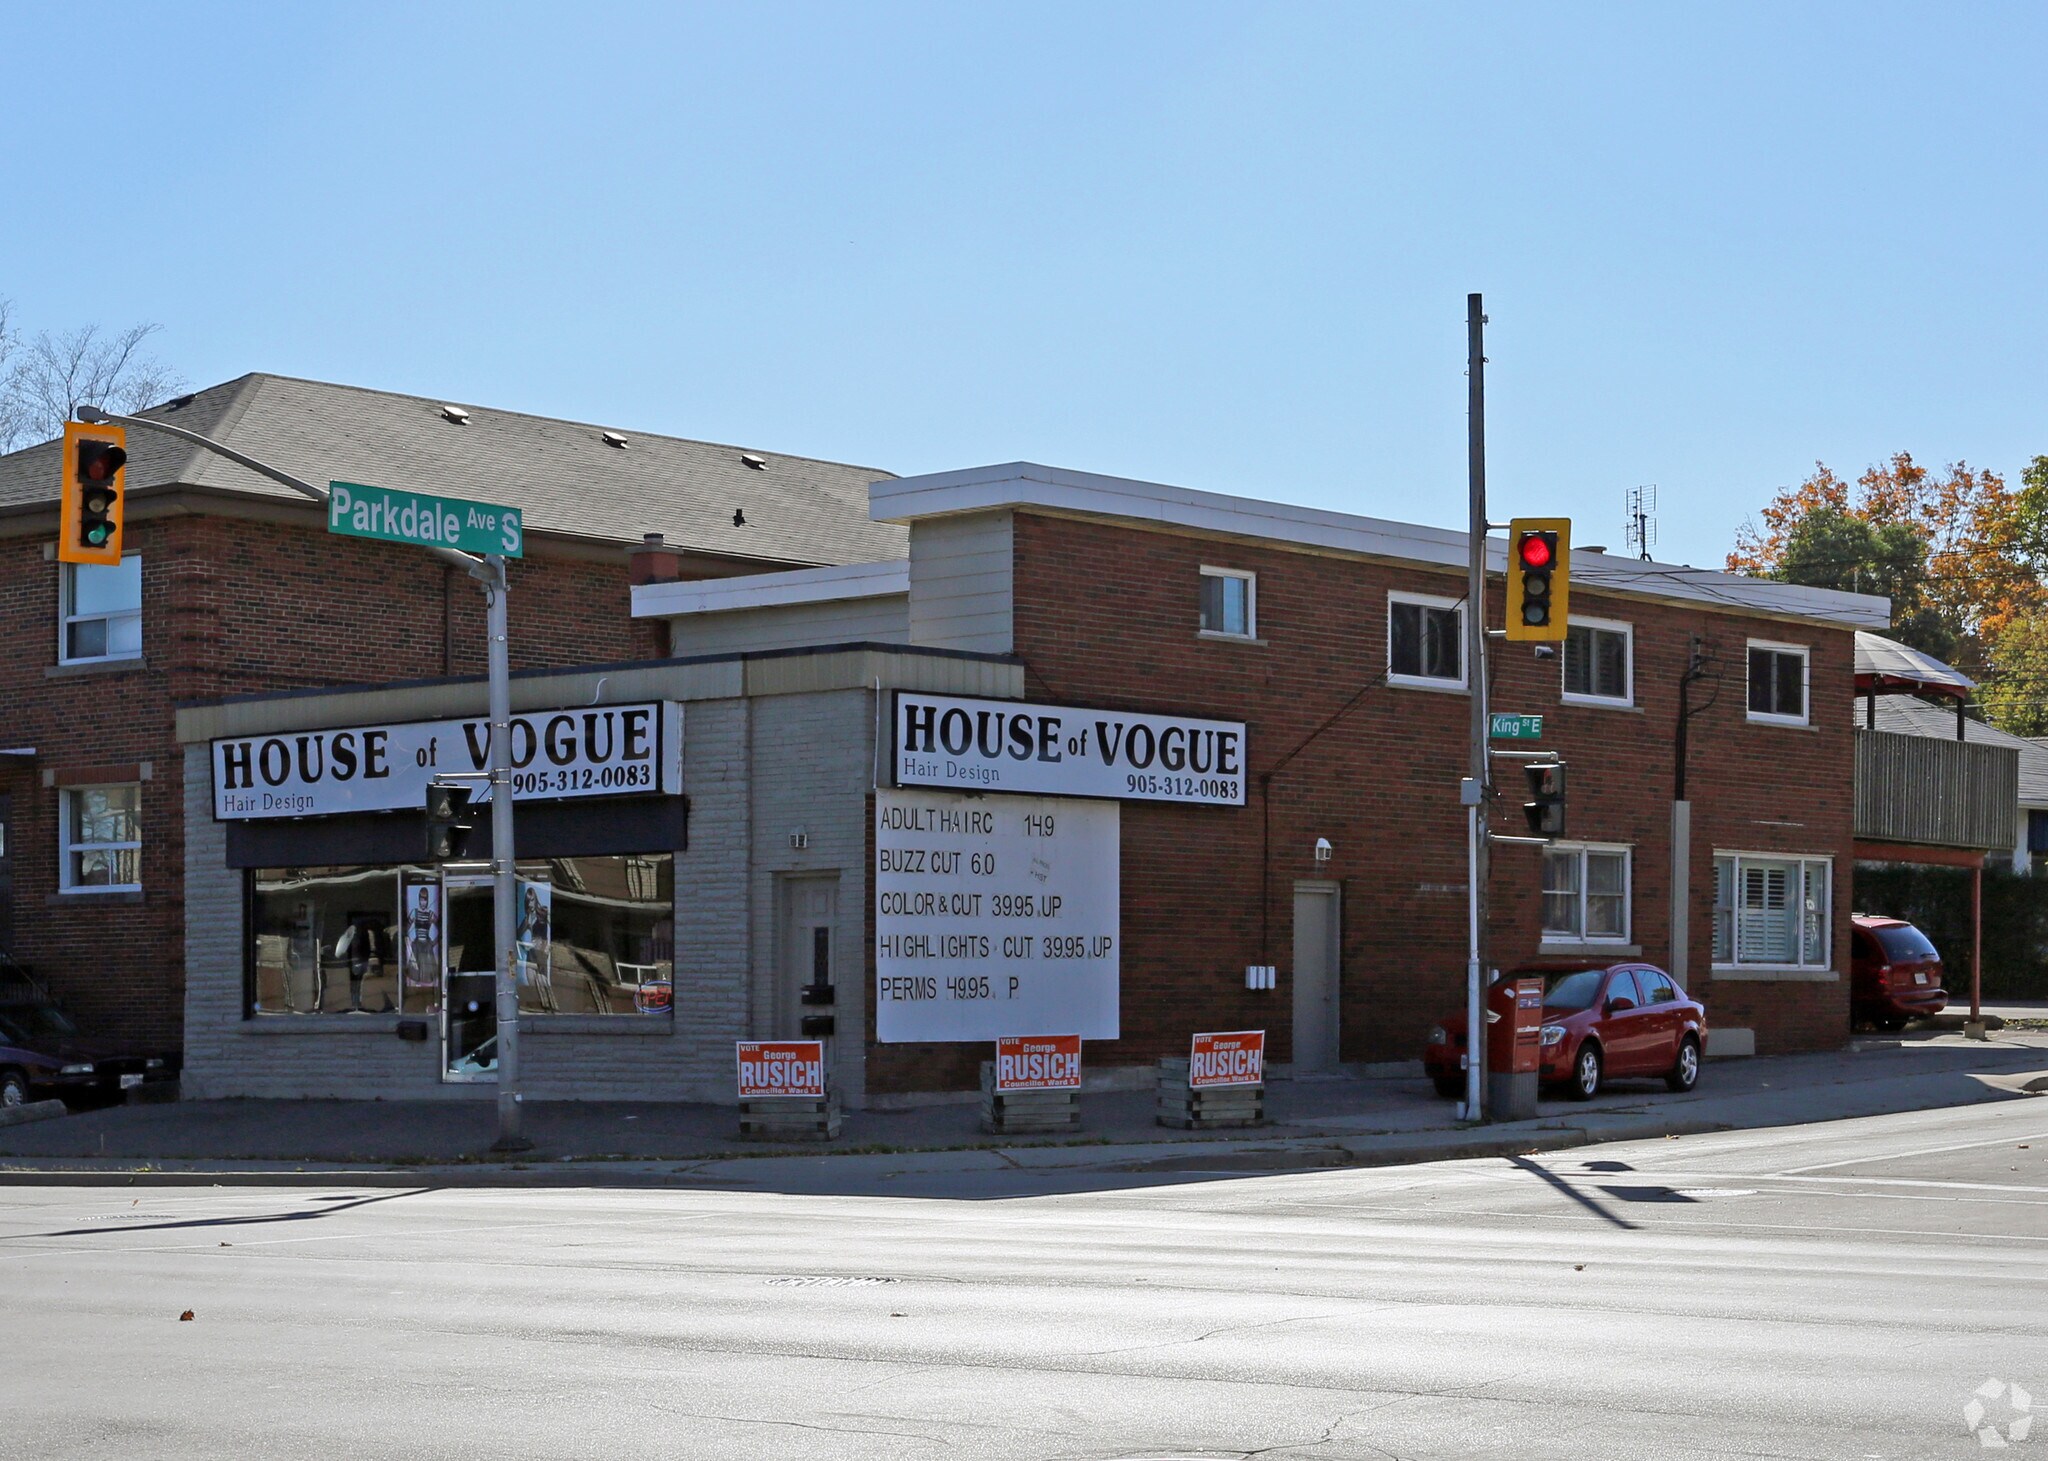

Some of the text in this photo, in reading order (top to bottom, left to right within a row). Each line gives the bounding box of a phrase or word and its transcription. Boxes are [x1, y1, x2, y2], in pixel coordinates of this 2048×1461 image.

[331, 486, 520, 552] Parkdale Ave S
[904, 704, 1239, 775] HOUSE of VOGUE
[1492, 718, 1541, 736] King St E
[222, 710, 650, 789] HOUSE of VOGUE
[513, 764, 650, 795] 905-312-0083
[904, 758, 1000, 785] Hair Design
[1127, 774, 1239, 800] 905-312-0083
[224, 793, 314, 812] Hair Design
[880, 807, 936, 832] ADULT
[940, 810, 993, 834] HAIRC
[880, 849, 995, 875] BUZZ CUT 6.0
[880, 892, 935, 916] COLOR
[938, 896, 948, 913] &
[951, 893, 982, 916] CUT
[992, 895, 1034, 917] 39.95
[1041, 896, 1062, 918] UP
[880, 935, 990, 958] HIGHLIGHTS
[1003, 936, 1034, 959] CUT
[1043, 936, 1085, 958] 39.95
[1092, 936, 1113, 958] UP
[880, 976, 937, 1000] PERMS
[946, 976, 989, 999] 49.95
[763, 1050, 797, 1060] George
[1023, 1043, 1056, 1053] George
[1213, 1041, 1241, 1050] George
[741, 1061, 820, 1087] RUSICH
[1000, 1053, 1079, 1080] RUSICH
[1194, 1049, 1260, 1078] RUSICH
[745, 1087, 786, 1095] Councillor
[788, 1087, 809, 1095] Ward
[1047, 1079, 1068, 1087] Ward
